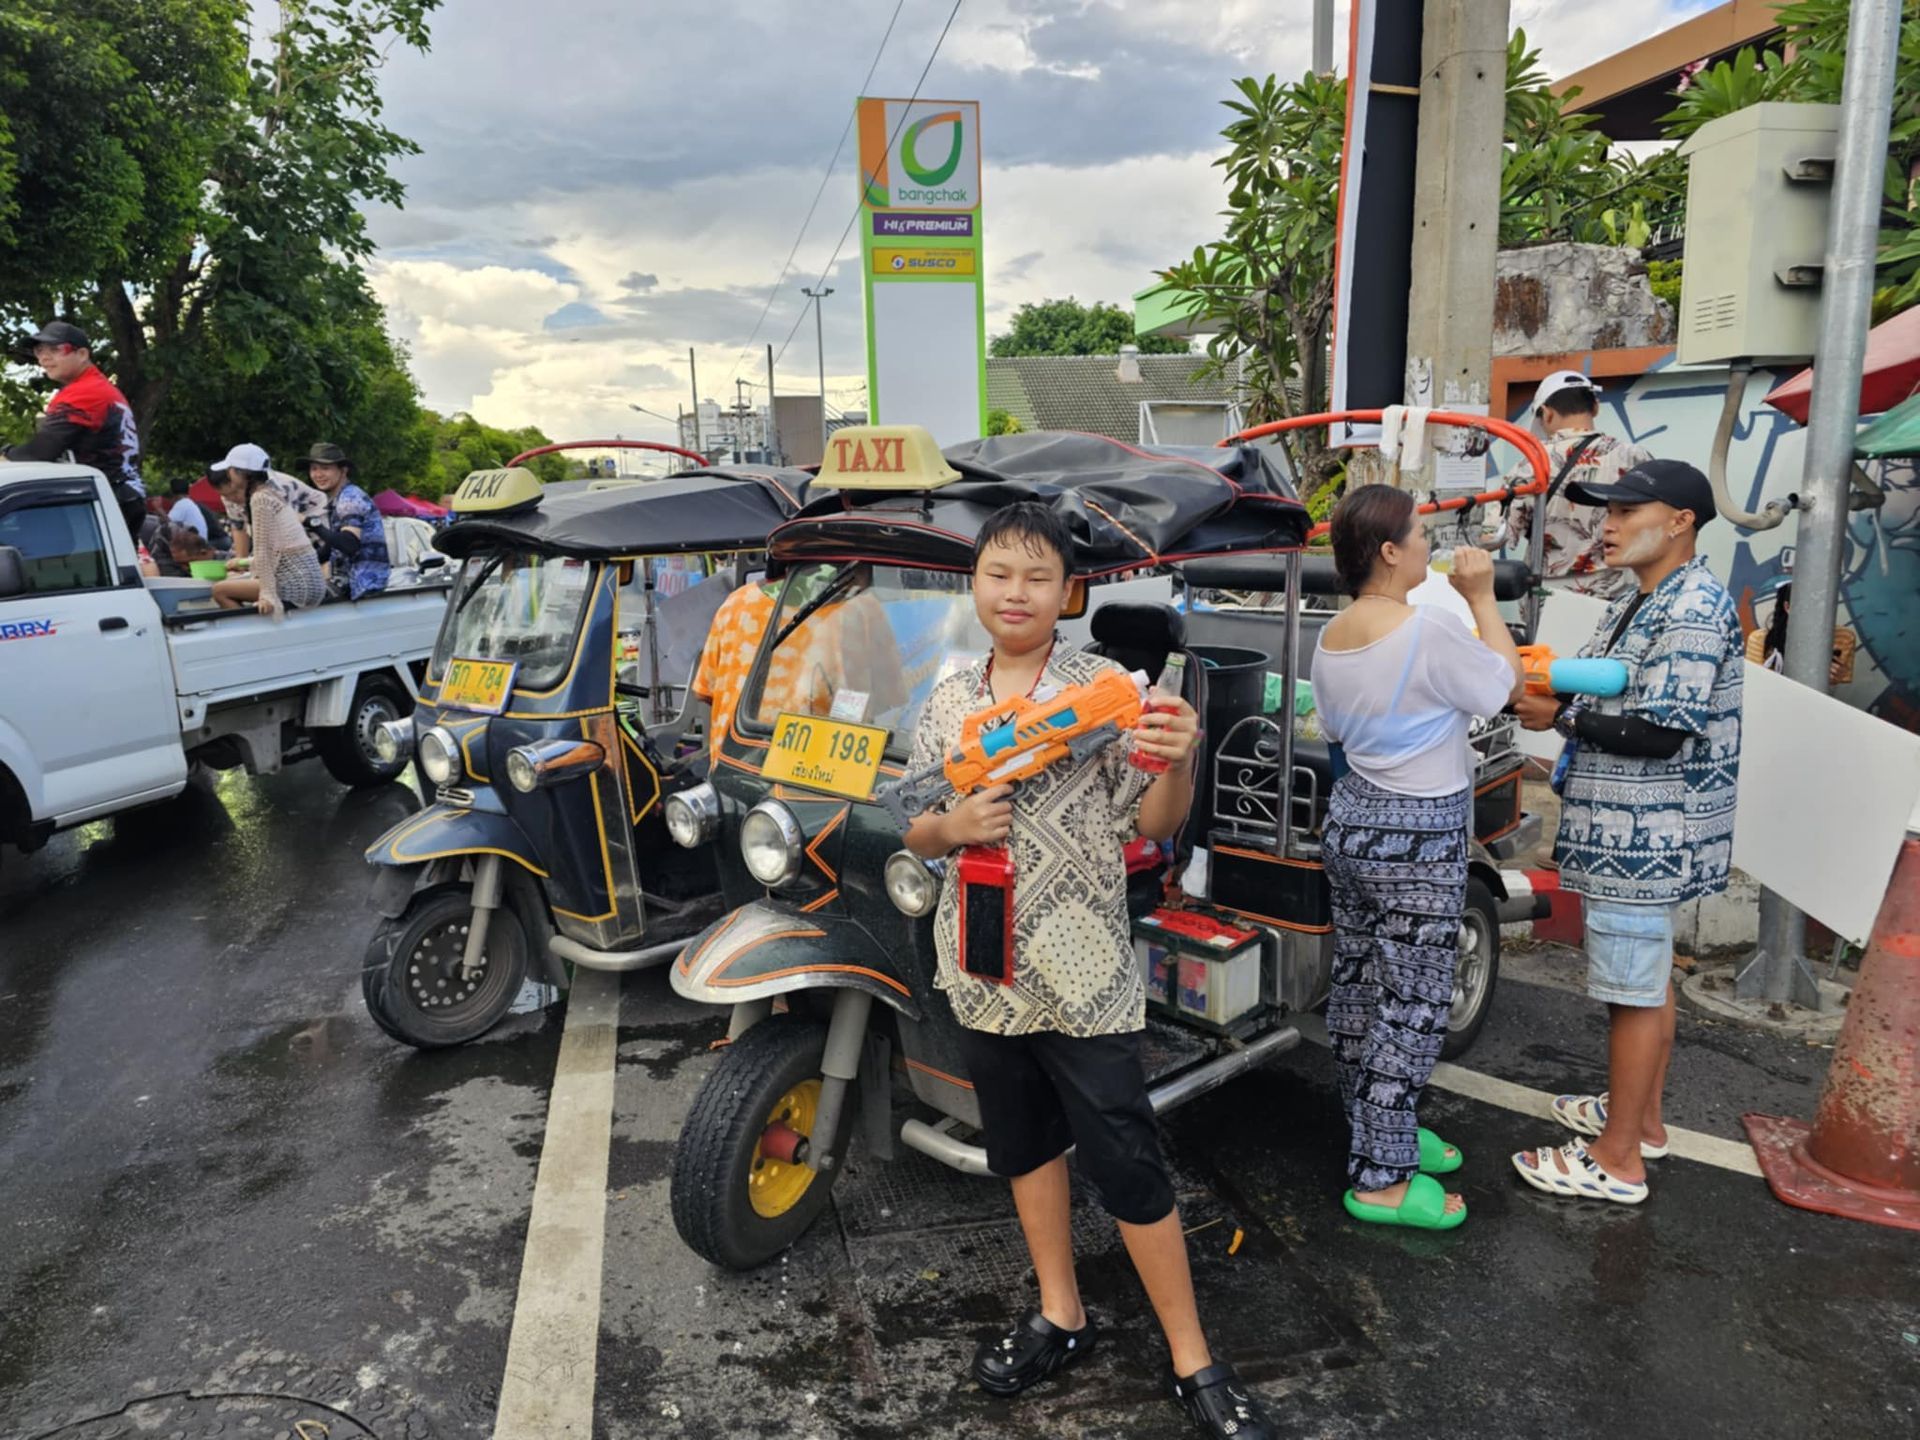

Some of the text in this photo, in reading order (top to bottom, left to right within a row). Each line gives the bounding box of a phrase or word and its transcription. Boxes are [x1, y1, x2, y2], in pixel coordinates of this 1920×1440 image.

[898, 188, 967, 204] bangchak
[906, 220, 968, 231] PREMIUM
[908, 258, 956, 268] SUSCO
[833, 438, 906, 473] TAXI
[461, 473, 508, 500] TAXI
[0, 619, 51, 639] RRY
[477, 665, 505, 690] 784
[829, 730, 869, 764] 198
[791, 761, 836, 784] เชียงใหม่
